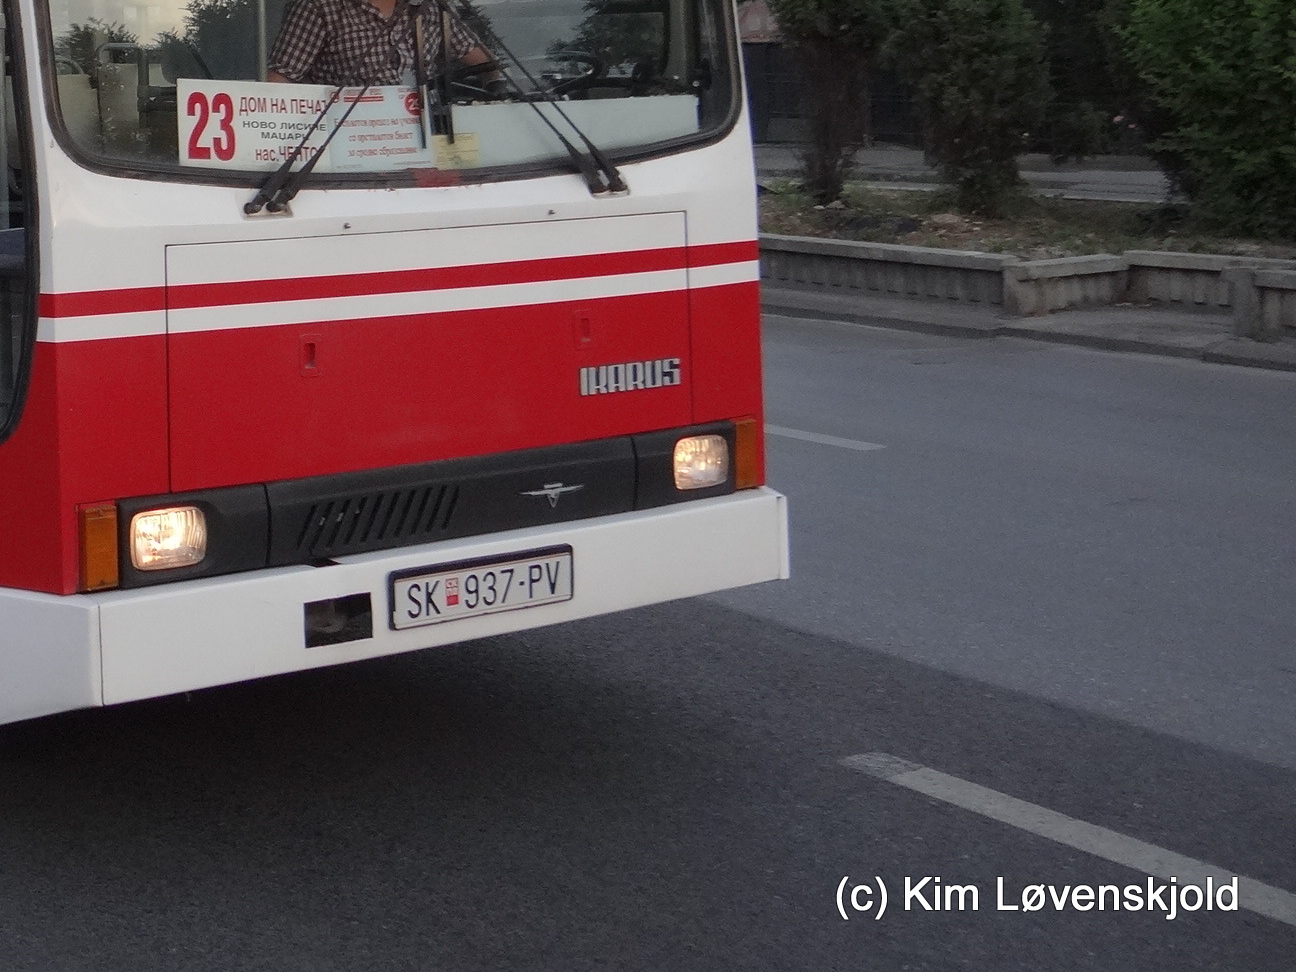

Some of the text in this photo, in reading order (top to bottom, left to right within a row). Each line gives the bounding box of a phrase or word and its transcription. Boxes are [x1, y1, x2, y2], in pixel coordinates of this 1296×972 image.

[239, 96, 267, 116] ДОМ
[270, 98, 288, 114] НА
[242, 120, 277, 130] НОВО
[186, 91, 236, 161] 23
[580, 358, 681, 396] IKARUS
[407, 561, 559, 619] SK 937-PV
